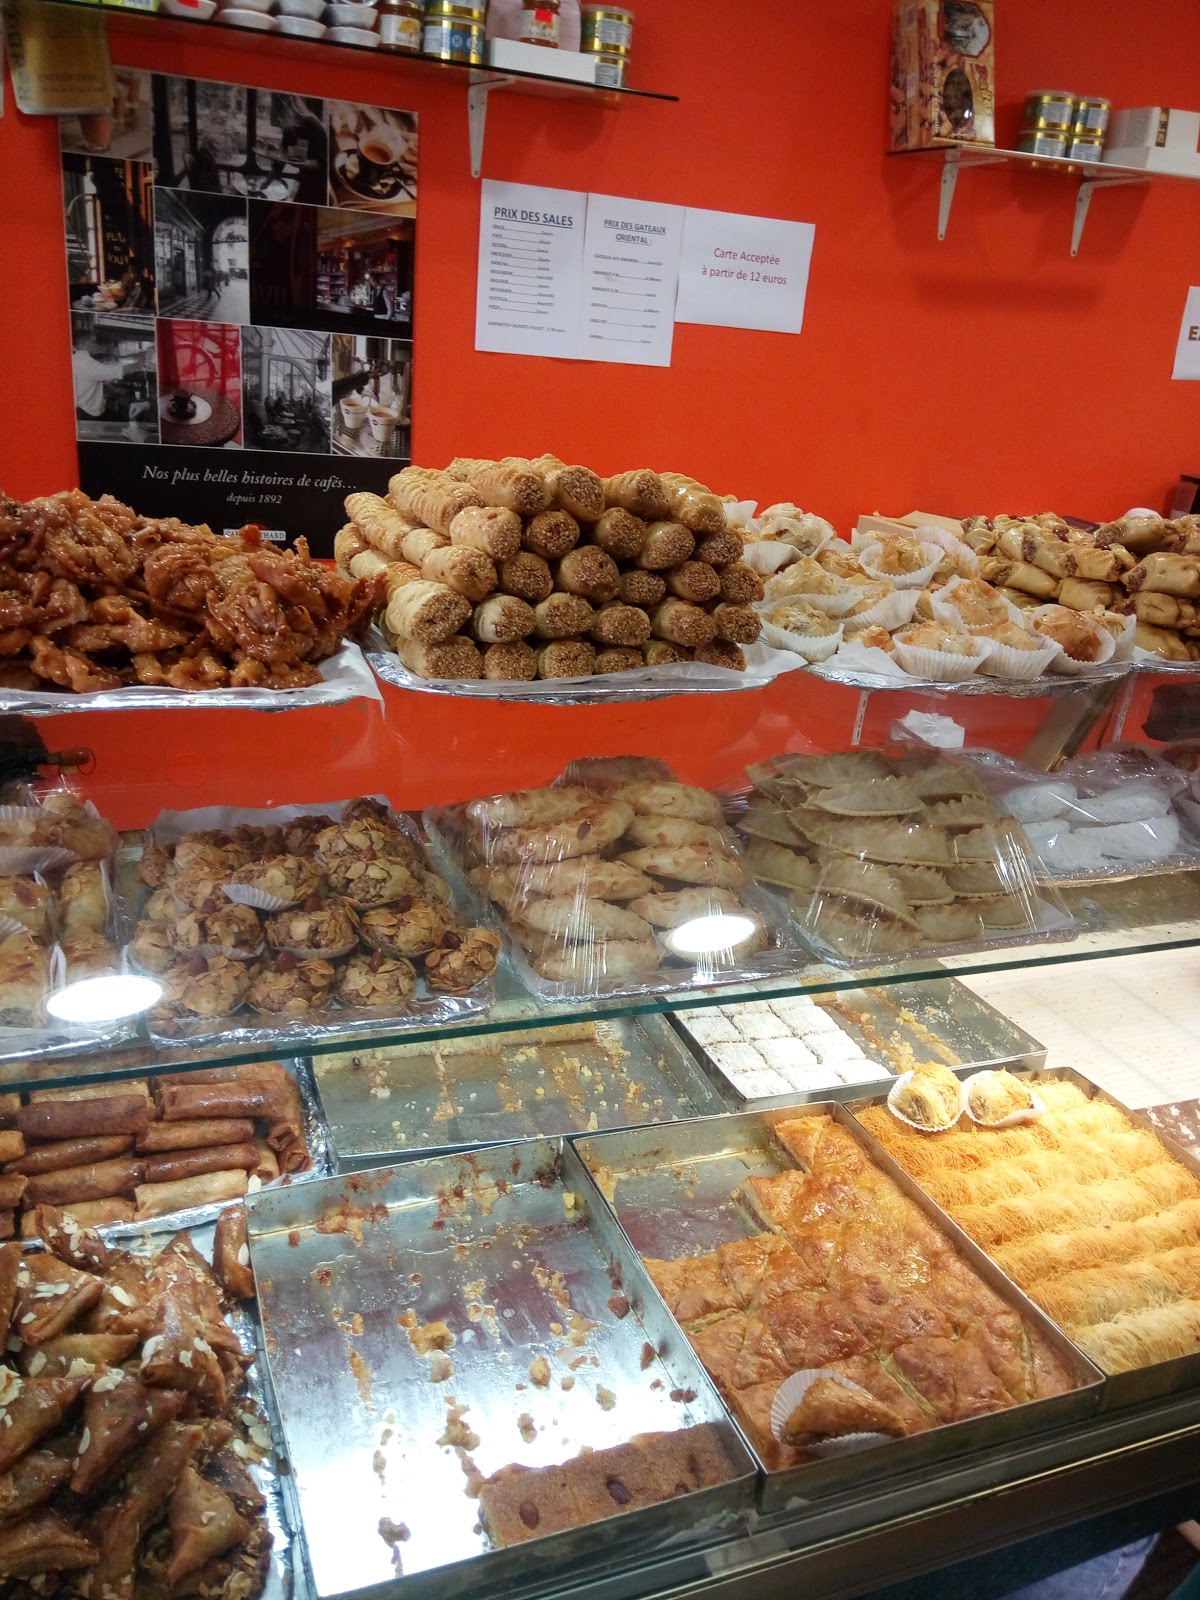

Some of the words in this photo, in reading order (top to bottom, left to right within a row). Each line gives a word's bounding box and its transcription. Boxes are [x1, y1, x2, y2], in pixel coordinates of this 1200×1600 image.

[494, 206, 518, 220] PRIX
[520, 210, 540, 222] DES
[542, 213, 573, 227] SALES
[604, 219, 619, 228] PRIX
[620, 221, 633, 230] DES
[634, 223, 666, 234] GATEAUX
[616, 233, 648, 244] ORIENTAL
[713, 247, 738, 260] Carte
[740, 251, 780, 266] Acceptée
[702, 265, 707, 275] à
[709, 268, 734, 278] partir
[736, 270, 748, 280] de
[750, 271, 761, 282] 12
[762, 274, 787, 285] euros
[142, 465, 169, 480] Nos
[172, 468, 200, 485] plus
[203, 469, 238, 484] belles
[241, 471, 293, 486] histoires
[297, 474, 312, 487] de
[226, 492, 256, 505] depuis
[259, 494, 283, 504] 1892
